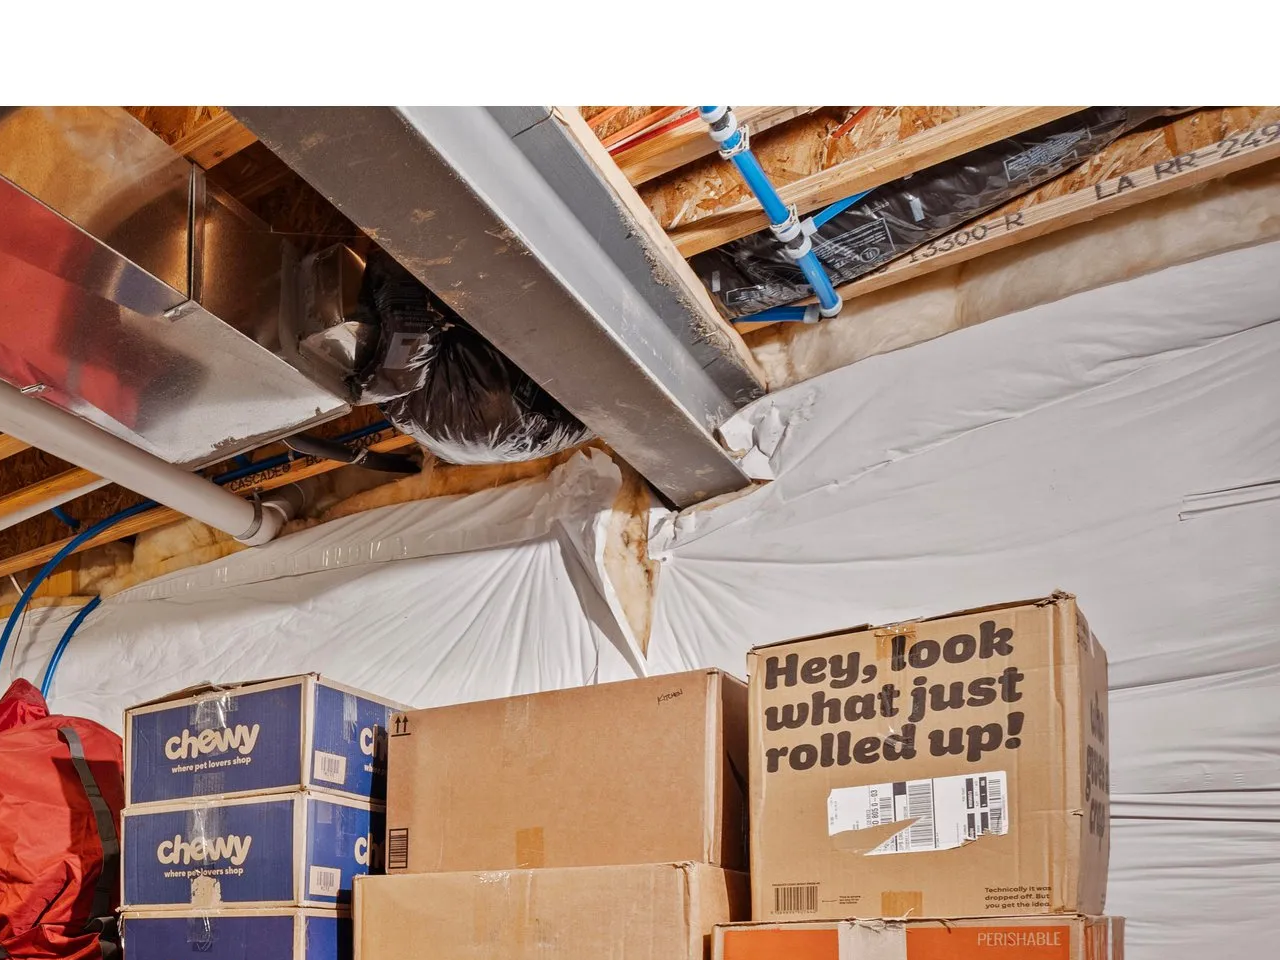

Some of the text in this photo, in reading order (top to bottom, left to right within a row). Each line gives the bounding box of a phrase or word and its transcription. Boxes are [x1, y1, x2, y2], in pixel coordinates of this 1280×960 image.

[764, 620, 1013, 690] Hey, look
[765, 667, 1024, 732] what just
[165, 724, 260, 760] chewy
[765, 711, 1025, 773] rolled up!
[171, 756, 252, 774] where pet lovers shop
[157, 834, 252, 865] chewy
[164, 868, 186, 878] where
[225, 865, 243, 876] shop
[977, 931, 1061, 947] PERISHABLE
